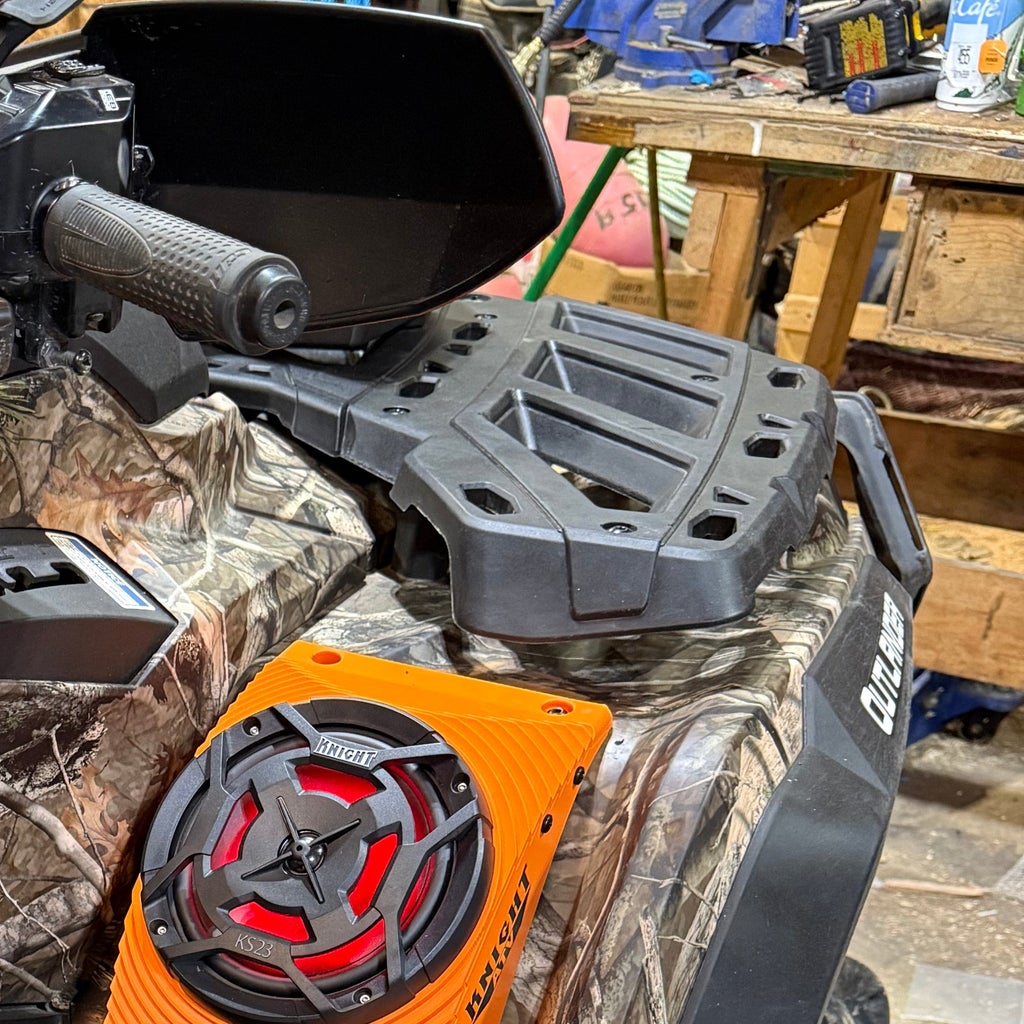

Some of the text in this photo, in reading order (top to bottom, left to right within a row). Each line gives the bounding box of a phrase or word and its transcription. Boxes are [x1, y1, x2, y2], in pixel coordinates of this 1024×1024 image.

[860, 591, 905, 736] OUTLANDER
[315, 737, 377, 767] KNIGHT
[235, 933, 274, 958] KS23
[465, 863, 529, 1022] KNIGHT
